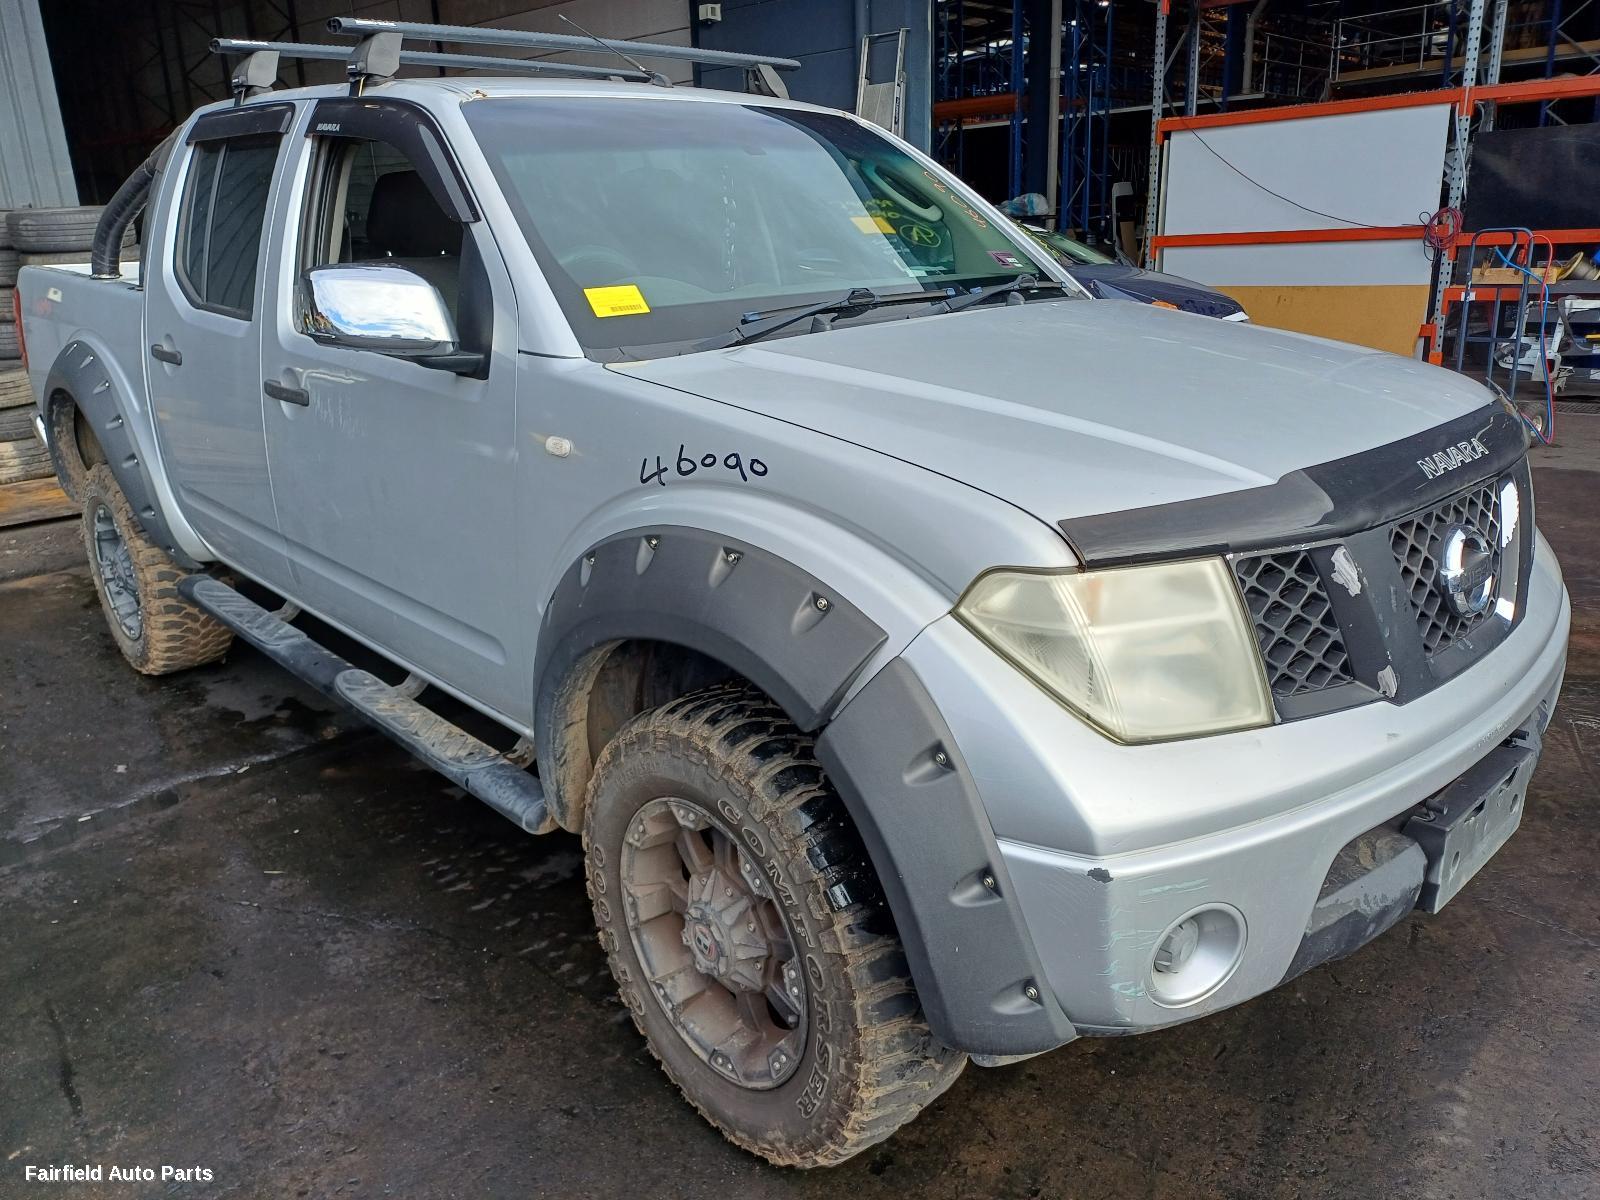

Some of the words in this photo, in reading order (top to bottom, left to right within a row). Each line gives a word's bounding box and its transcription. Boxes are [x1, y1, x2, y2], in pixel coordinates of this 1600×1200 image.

[639, 443, 768, 486] 46090
[1416, 437, 1490, 480] NAVARA
[717, 798, 836, 1120] COMFORSER
